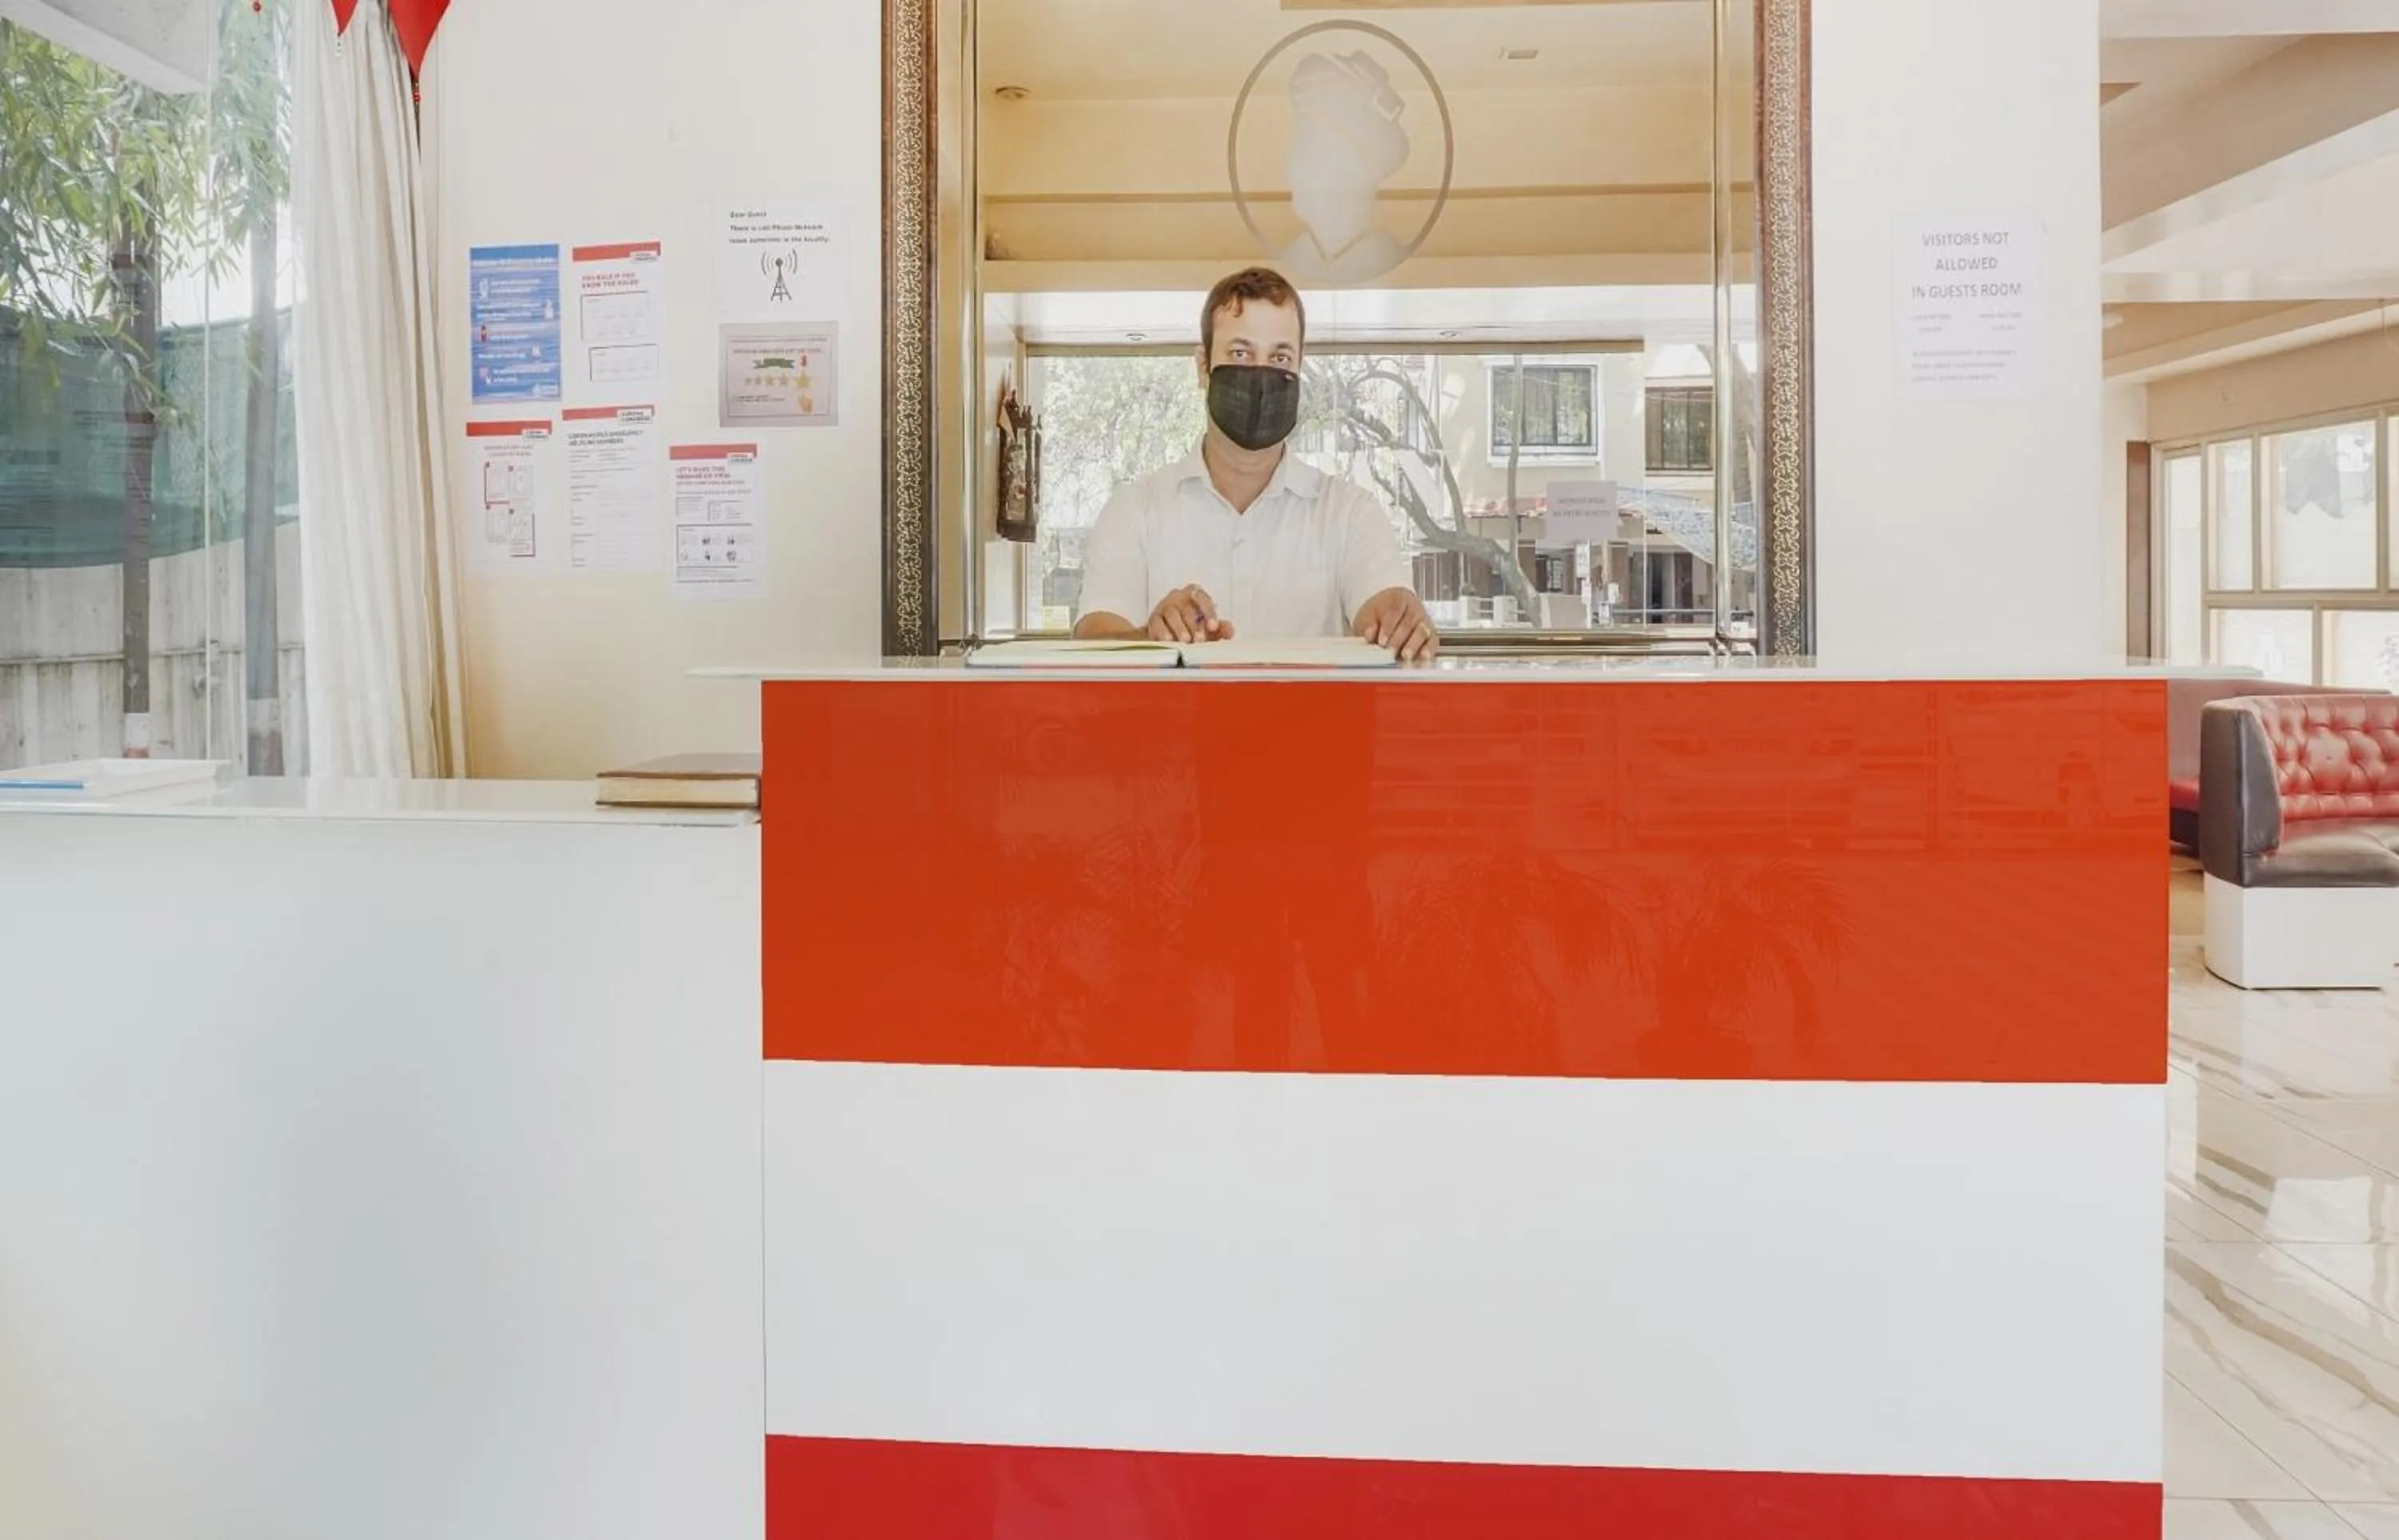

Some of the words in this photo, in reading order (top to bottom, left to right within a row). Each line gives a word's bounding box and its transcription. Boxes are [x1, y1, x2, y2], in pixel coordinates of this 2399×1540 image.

[1922, 233, 1980, 246] VISITORS
[1982, 231, 2010, 245] NOT
[1935, 257, 1998, 271] ALLOWED
[1911, 285, 1926, 299] IN
[1929, 284, 1978, 298] GUESTS
[1981, 282, 2022, 297] ROOM
